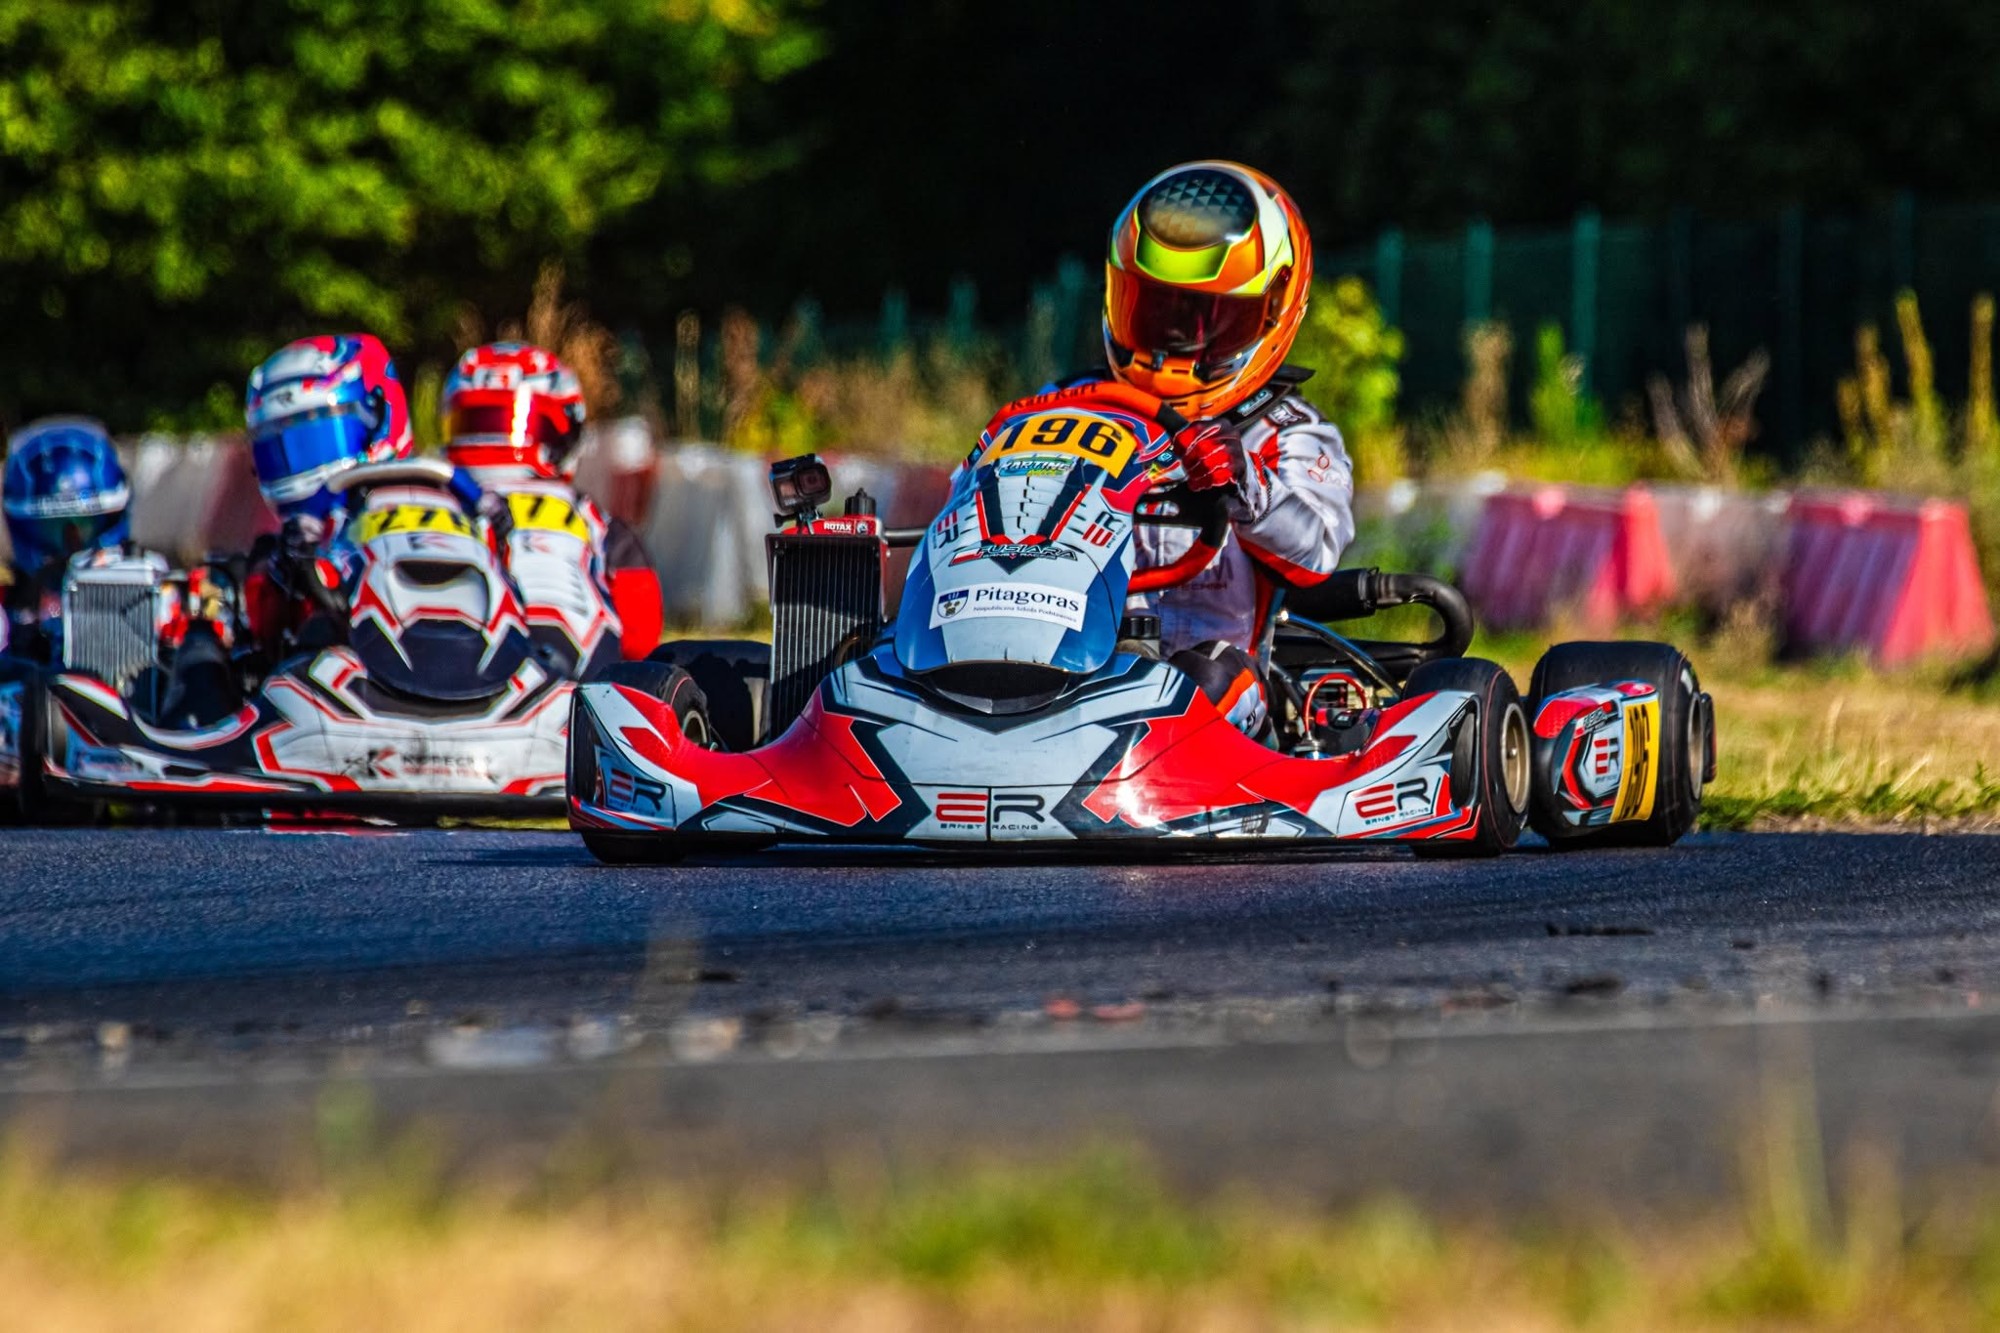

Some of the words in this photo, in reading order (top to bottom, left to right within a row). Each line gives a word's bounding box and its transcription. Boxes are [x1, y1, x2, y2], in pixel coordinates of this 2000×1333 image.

[1001, 417, 1122, 458] 196
[1001, 460, 1072, 472] KARTING
[823, 520, 852, 531] ROTAX
[977, 543, 1078, 562] FUSIARA
[975, 586, 1080, 612] Pitagoras
[608, 768, 667, 812] ER
[1354, 777, 1432, 818] ER
[936, 793, 1046, 823] ER
